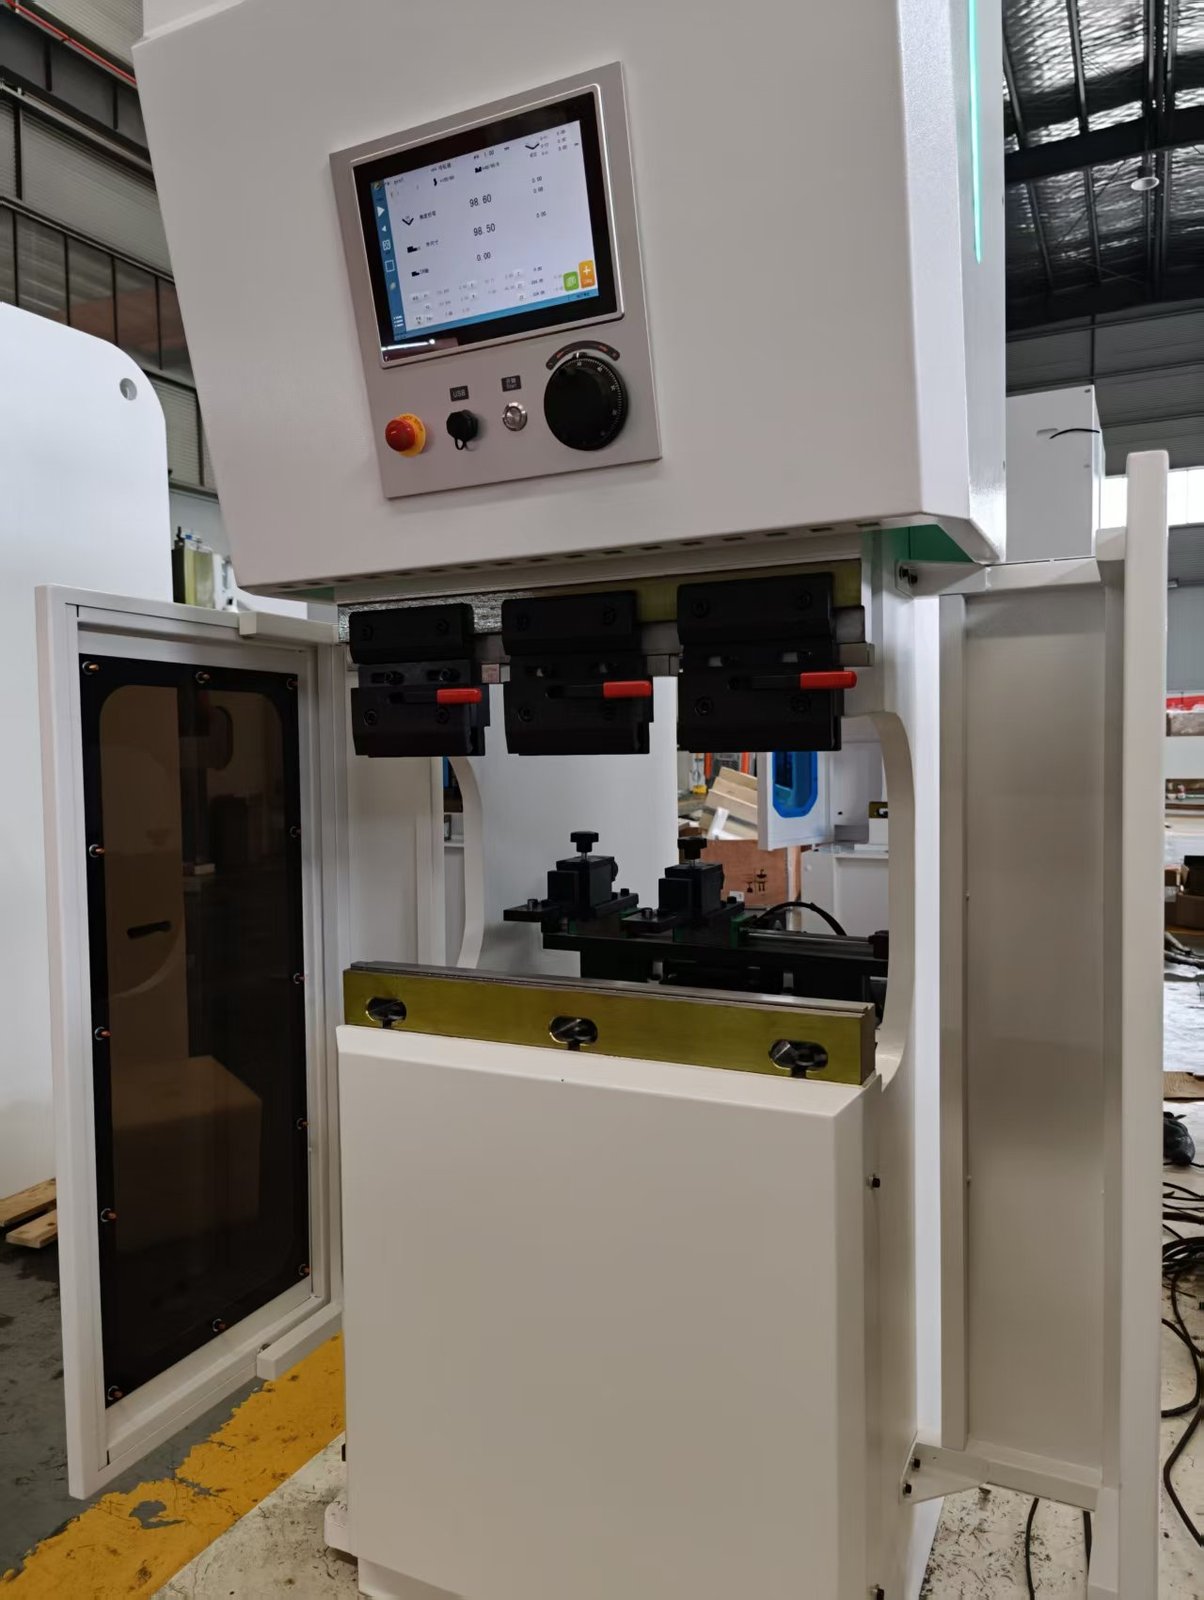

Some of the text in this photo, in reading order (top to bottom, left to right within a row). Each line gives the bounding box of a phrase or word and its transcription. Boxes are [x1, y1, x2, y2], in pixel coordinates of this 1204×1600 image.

[469, 193, 492, 208] 9860
[476, 251, 492, 262] 000
[453, 388, 466, 399] USB
